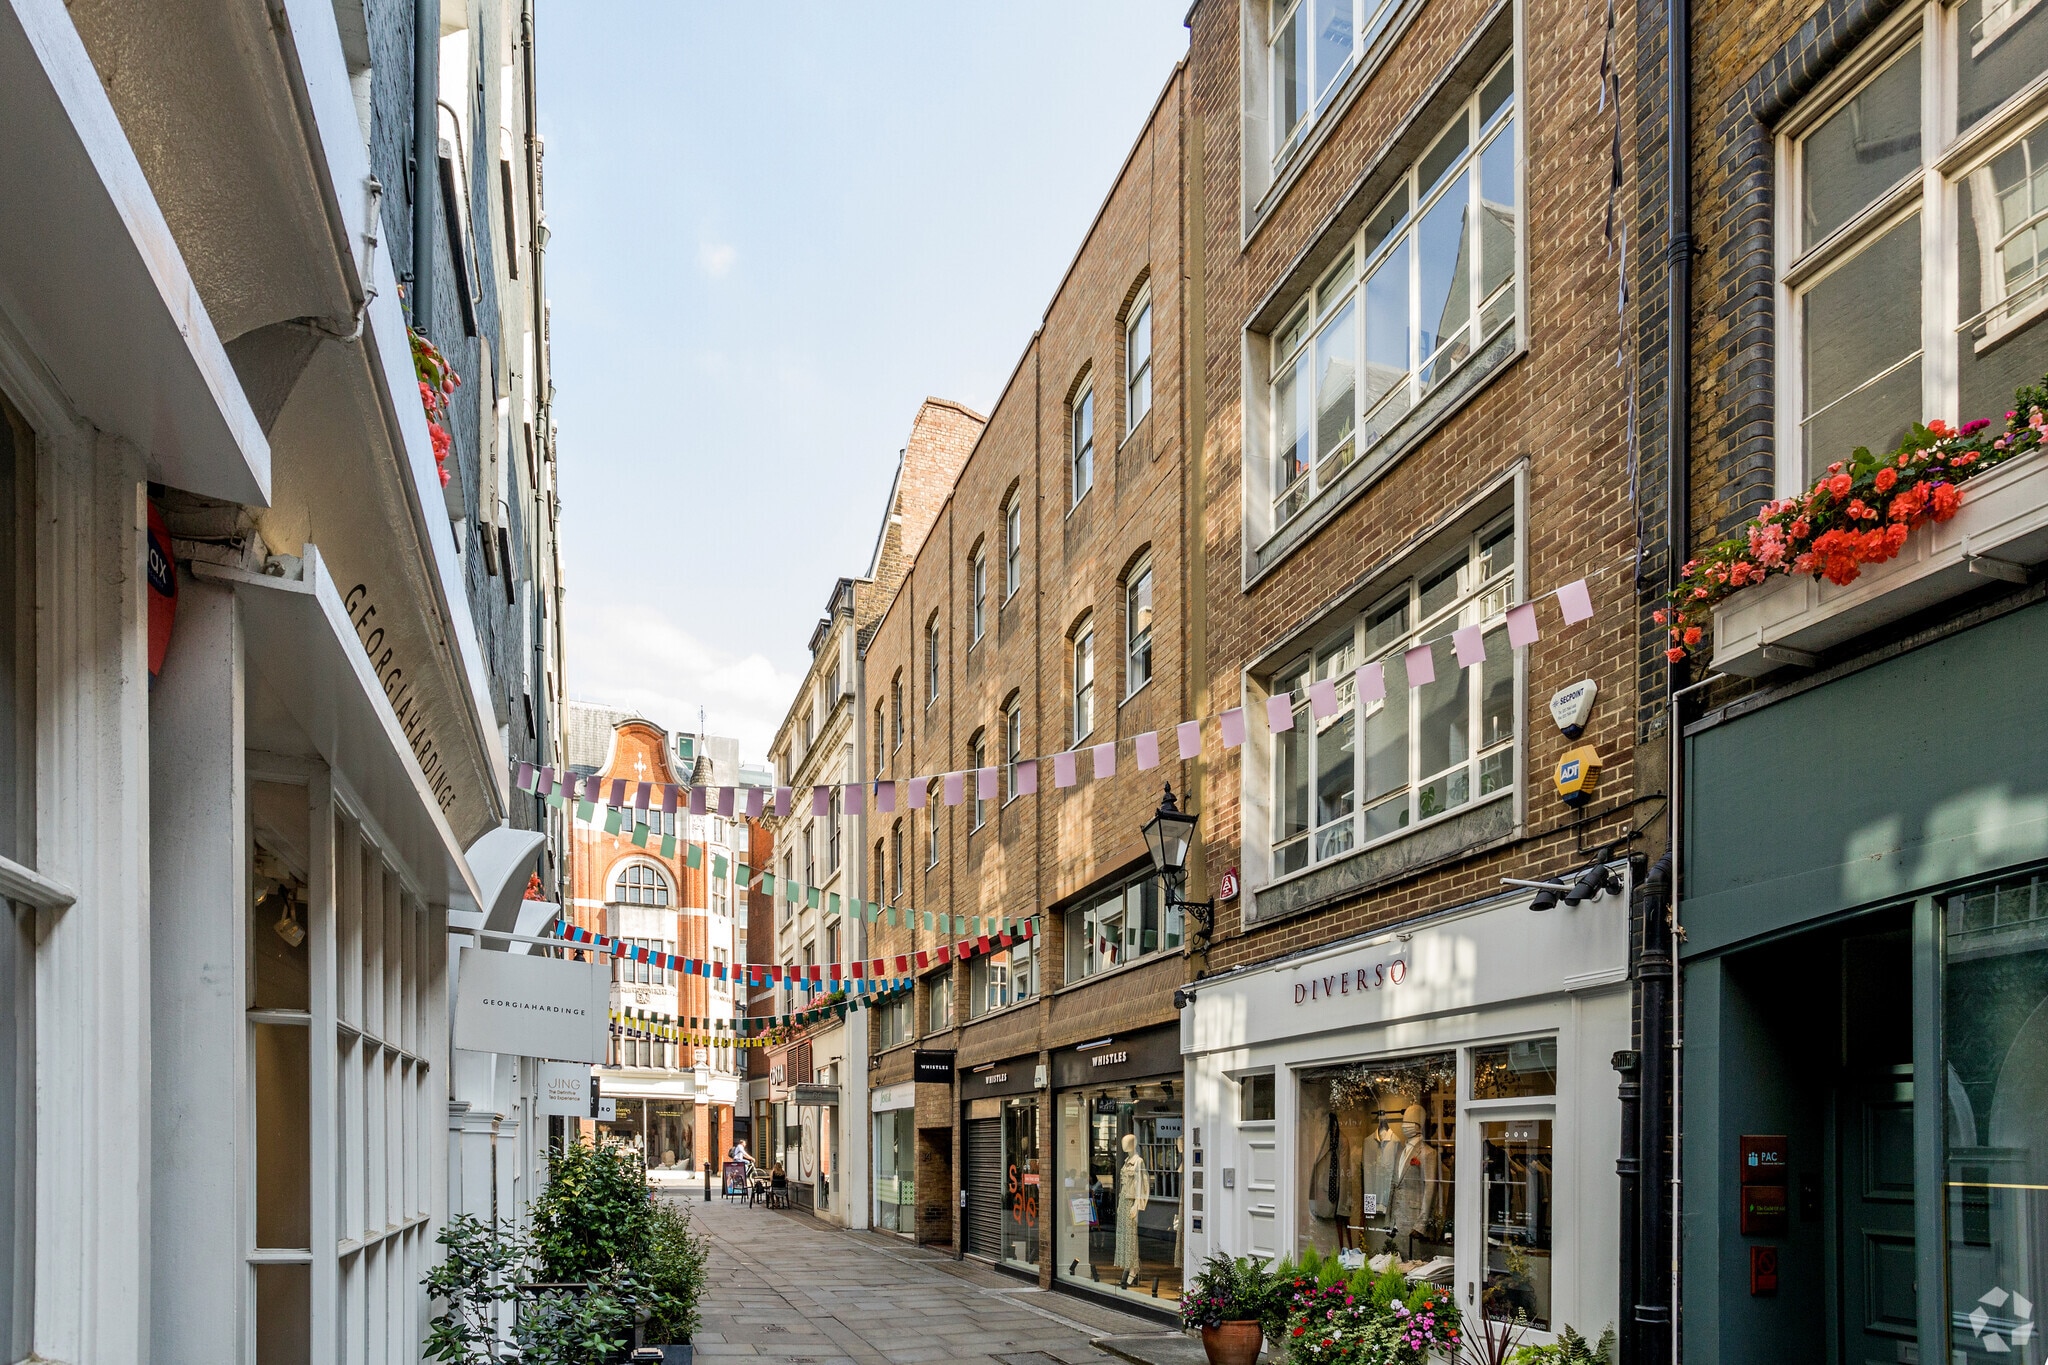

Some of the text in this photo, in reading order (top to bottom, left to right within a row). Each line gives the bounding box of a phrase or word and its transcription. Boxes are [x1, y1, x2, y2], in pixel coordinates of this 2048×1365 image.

[344, 583, 457, 815] GEORGIAHARDINGE
[1560, 687, 1585, 705] SECPOINT
[1561, 763, 1580, 780] ADT
[1294, 959, 1408, 1005] DIVERSO
[483, 998, 586, 1016] GEORGIAHARDINGE
[1091, 1051, 1127, 1067] WHISTLES
[548, 1078, 581, 1090] JING
[985, 1072, 1007, 1085] WHISTLES
[1761, 1152, 1778, 1162] PAC
